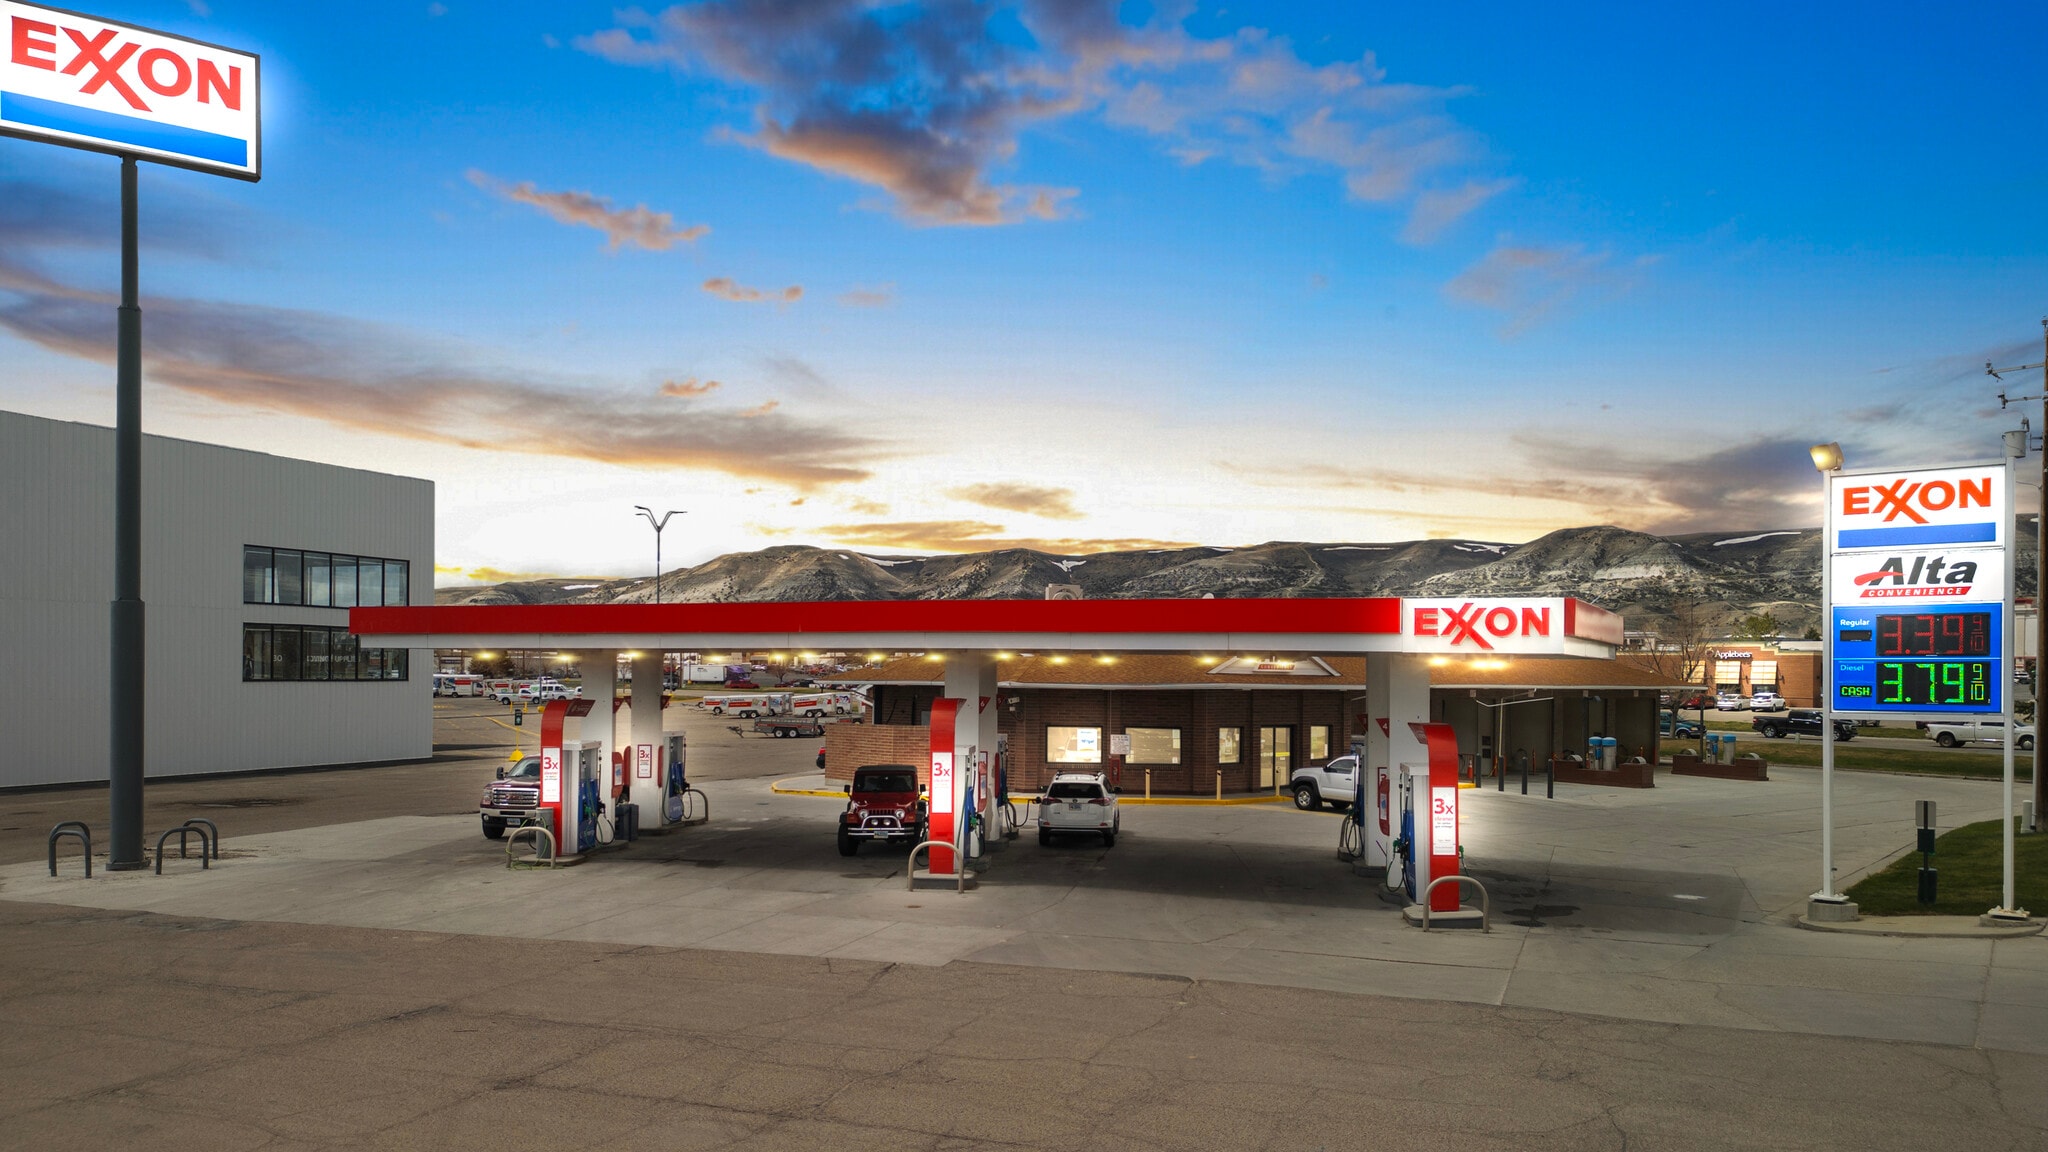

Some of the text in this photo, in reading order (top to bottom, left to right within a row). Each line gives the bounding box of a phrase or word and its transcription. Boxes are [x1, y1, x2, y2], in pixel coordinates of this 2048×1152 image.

[11, 15, 241, 112] EXXON
[1843, 477, 1991, 524] EXXON
[1868, 556, 1978, 586] Alta
[1868, 588, 1962, 597] CONVENIENCE
[1414, 602, 1550, 650] EXXON
[1840, 619, 1870, 627] Regular
[1883, 615, 1964, 654] 3.39
[1841, 686, 1871, 696] CASH
[1883, 664, 1964, 703] 3.79
[640, 750, 650, 759] 3x
[544, 757, 559, 770] 3x
[934, 762, 950, 777] 3x
[1434, 798, 1454, 815] 3x
